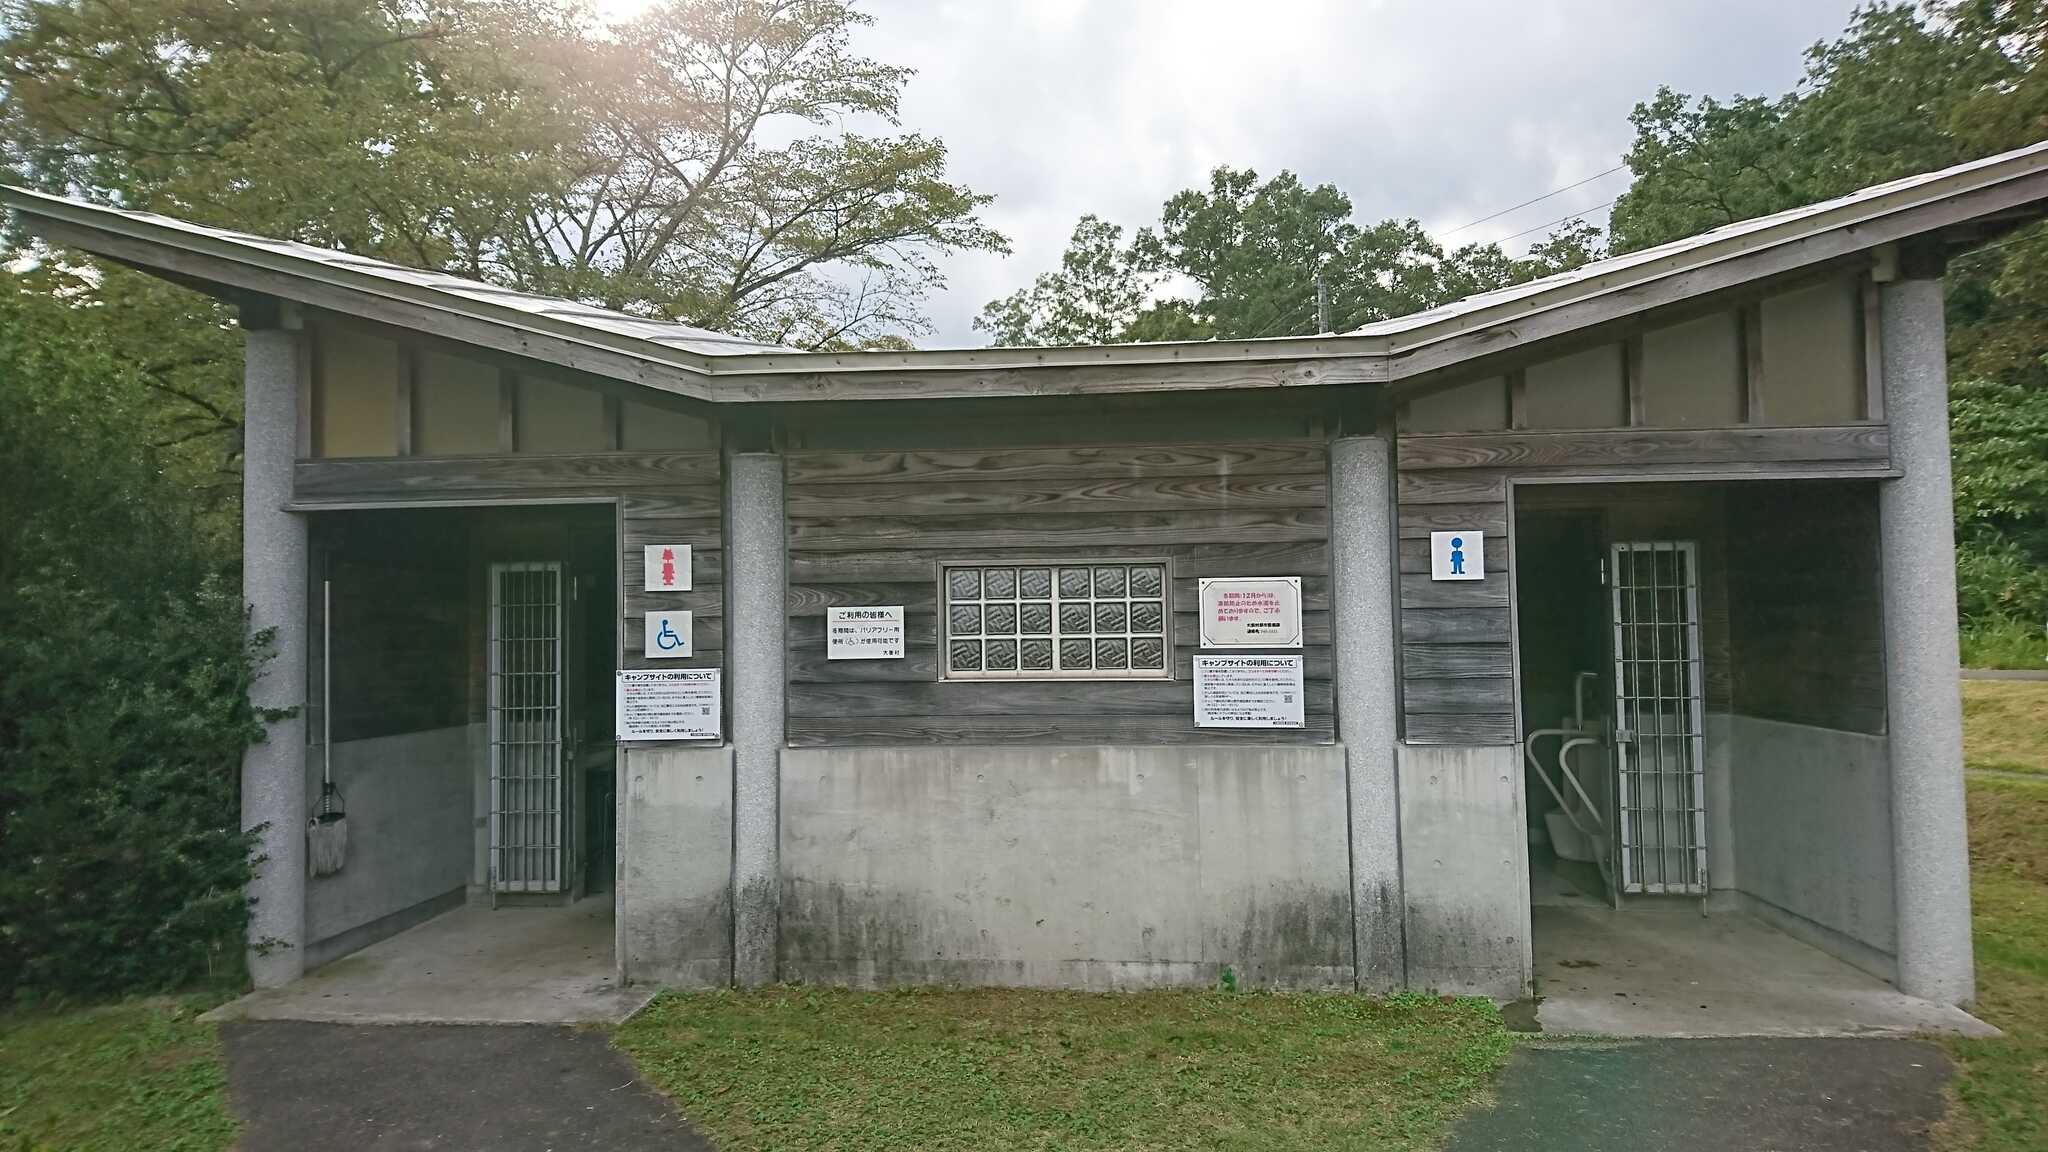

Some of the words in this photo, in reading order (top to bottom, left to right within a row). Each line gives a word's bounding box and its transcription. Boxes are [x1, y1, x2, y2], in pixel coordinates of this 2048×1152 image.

[838, 611, 893, 620] ご利用の皆様へ
[1201, 659, 1294, 668] キャンプサイトの利用について
[624, 672, 712, 681] キャンプサイトの利用について
